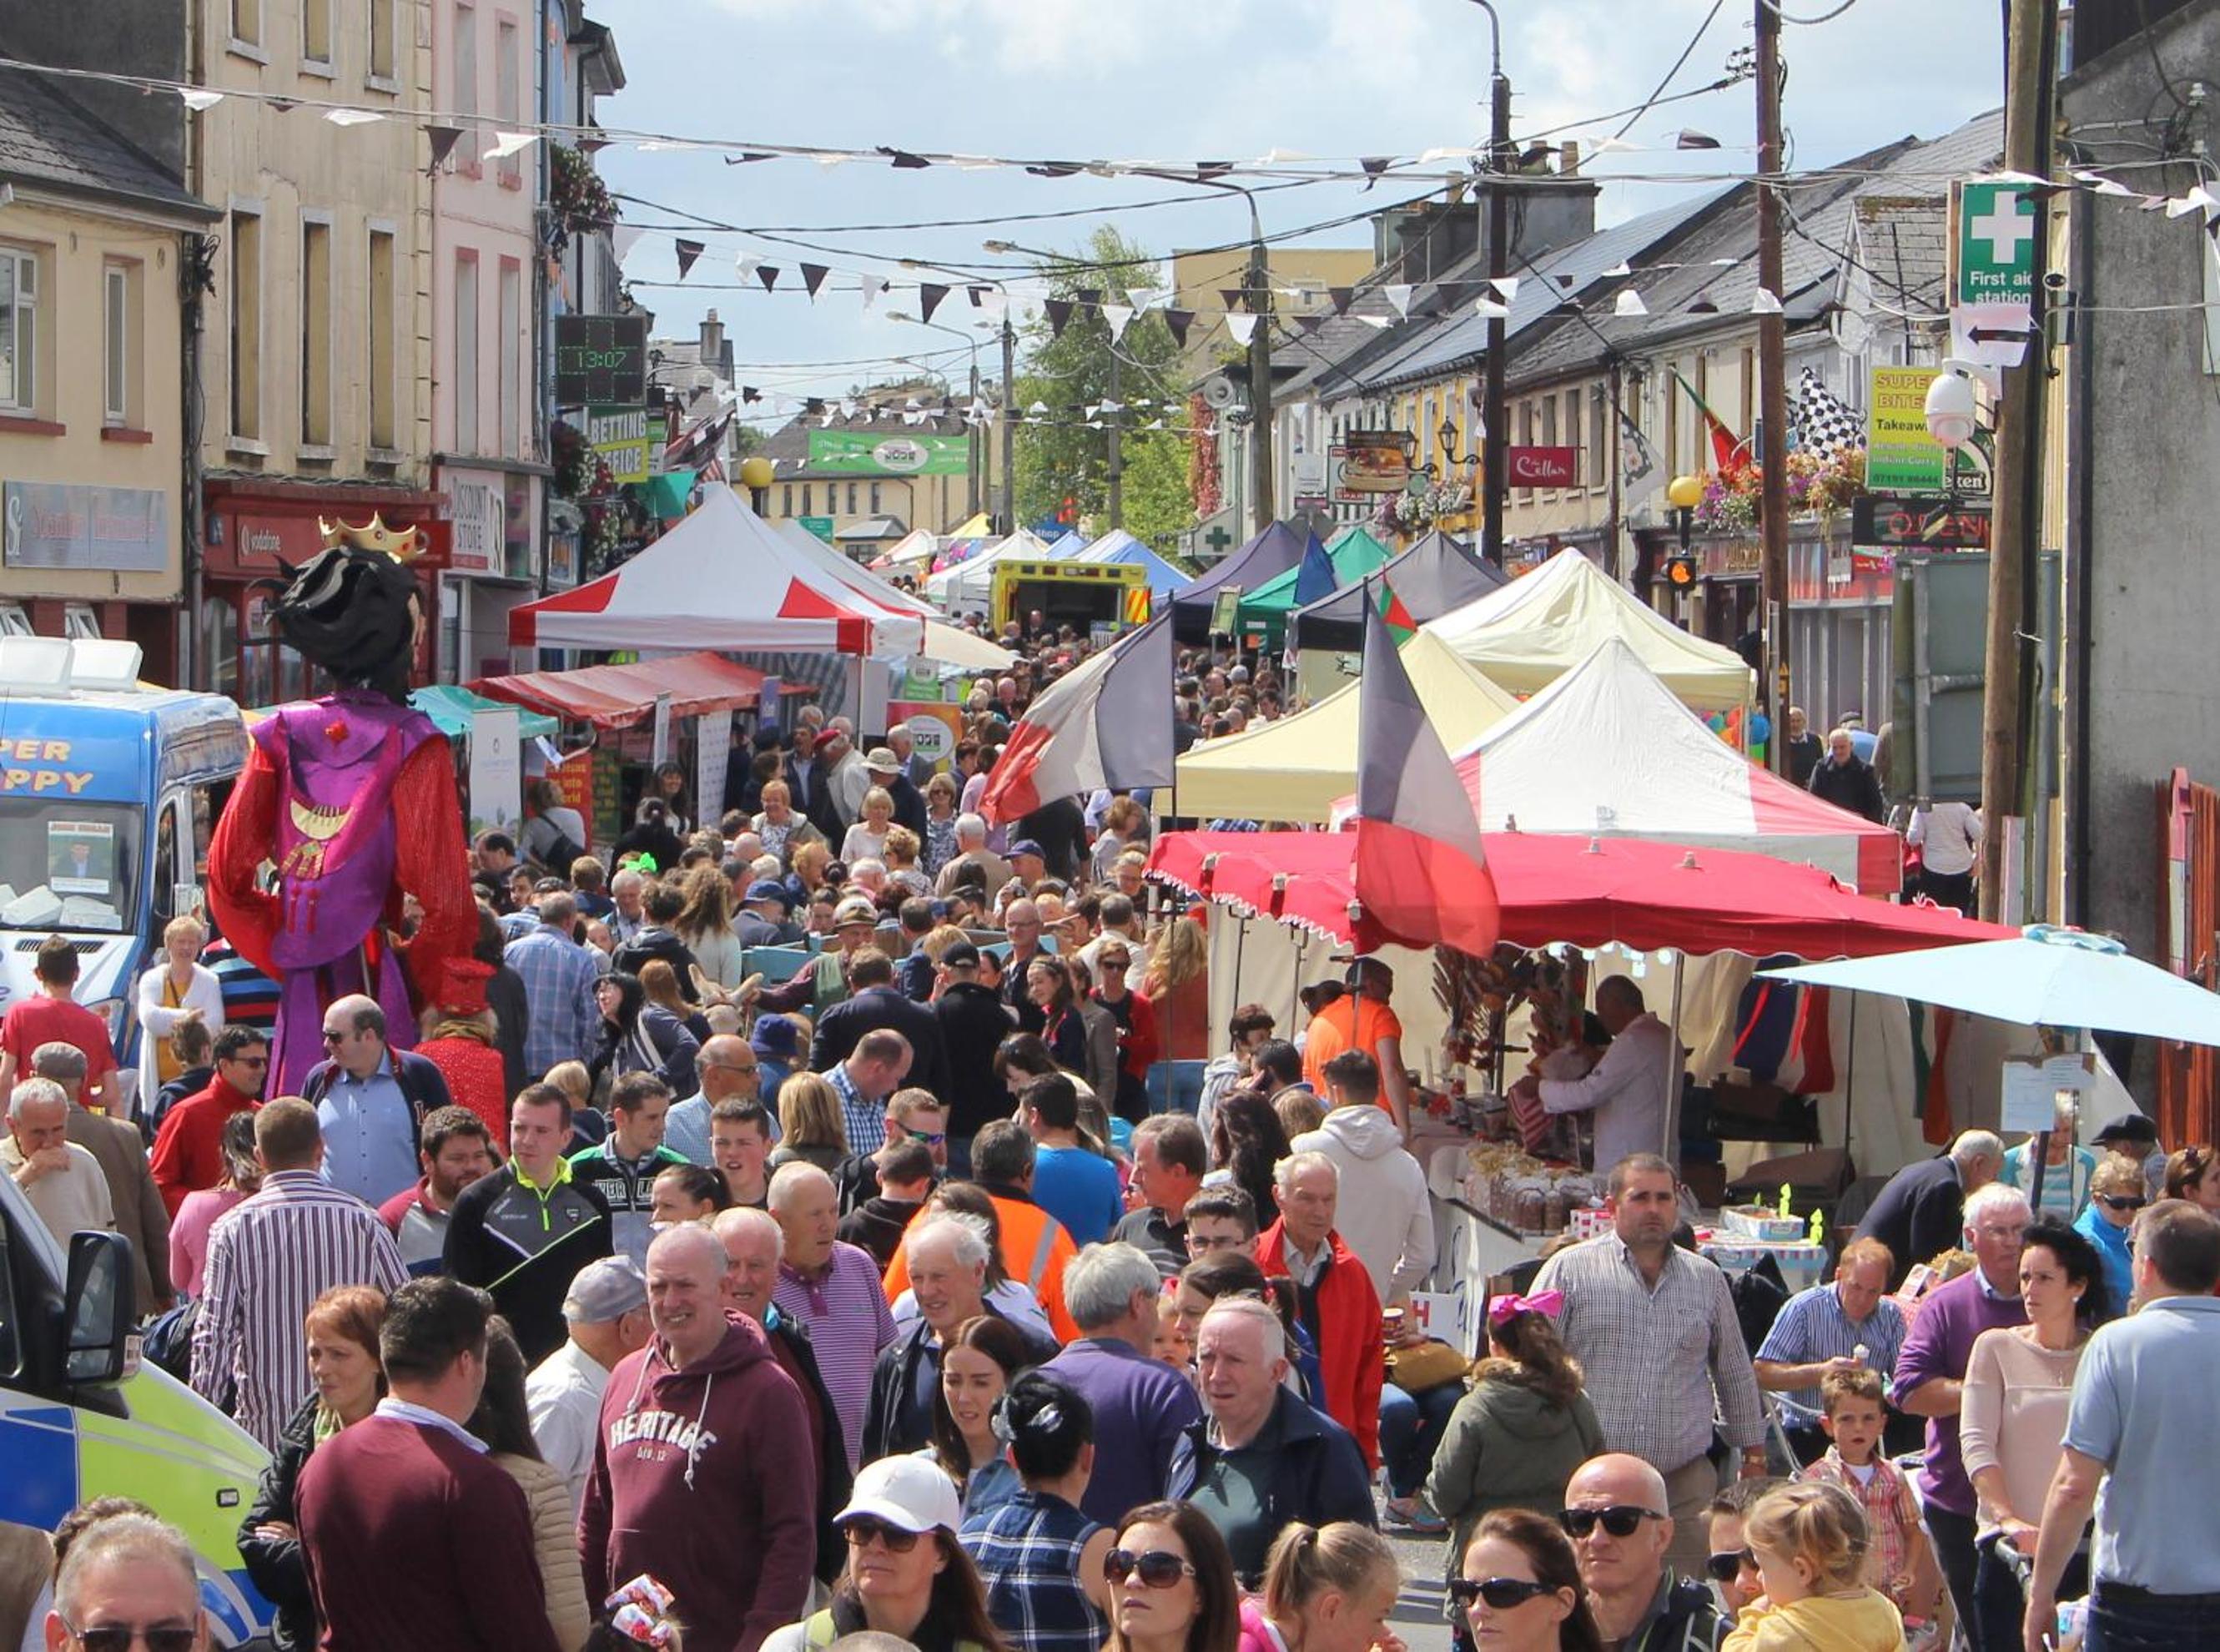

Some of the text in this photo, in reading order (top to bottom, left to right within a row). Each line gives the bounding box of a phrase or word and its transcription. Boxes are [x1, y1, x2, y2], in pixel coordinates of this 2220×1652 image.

[1971, 270, 2006, 286] First
[1975, 290, 2031, 303] station
[577, 350, 627, 368] 13:07
[1876, 375, 1935, 389] SUPE
[1878, 393, 1926, 408] BITE
[591, 411, 647, 444] BETTING
[1876, 418, 1928, 431] Takeaw
[604, 447, 642, 475] FFICE
[1516, 456, 1566, 478] Cellar
[452, 476, 488, 521] DISCOUNT
[458, 523, 483, 550] STORE
[0, 738, 72, 763] PER
[3, 768, 94, 794] PPY
[610, 1410, 718, 1462] HERITAGE
